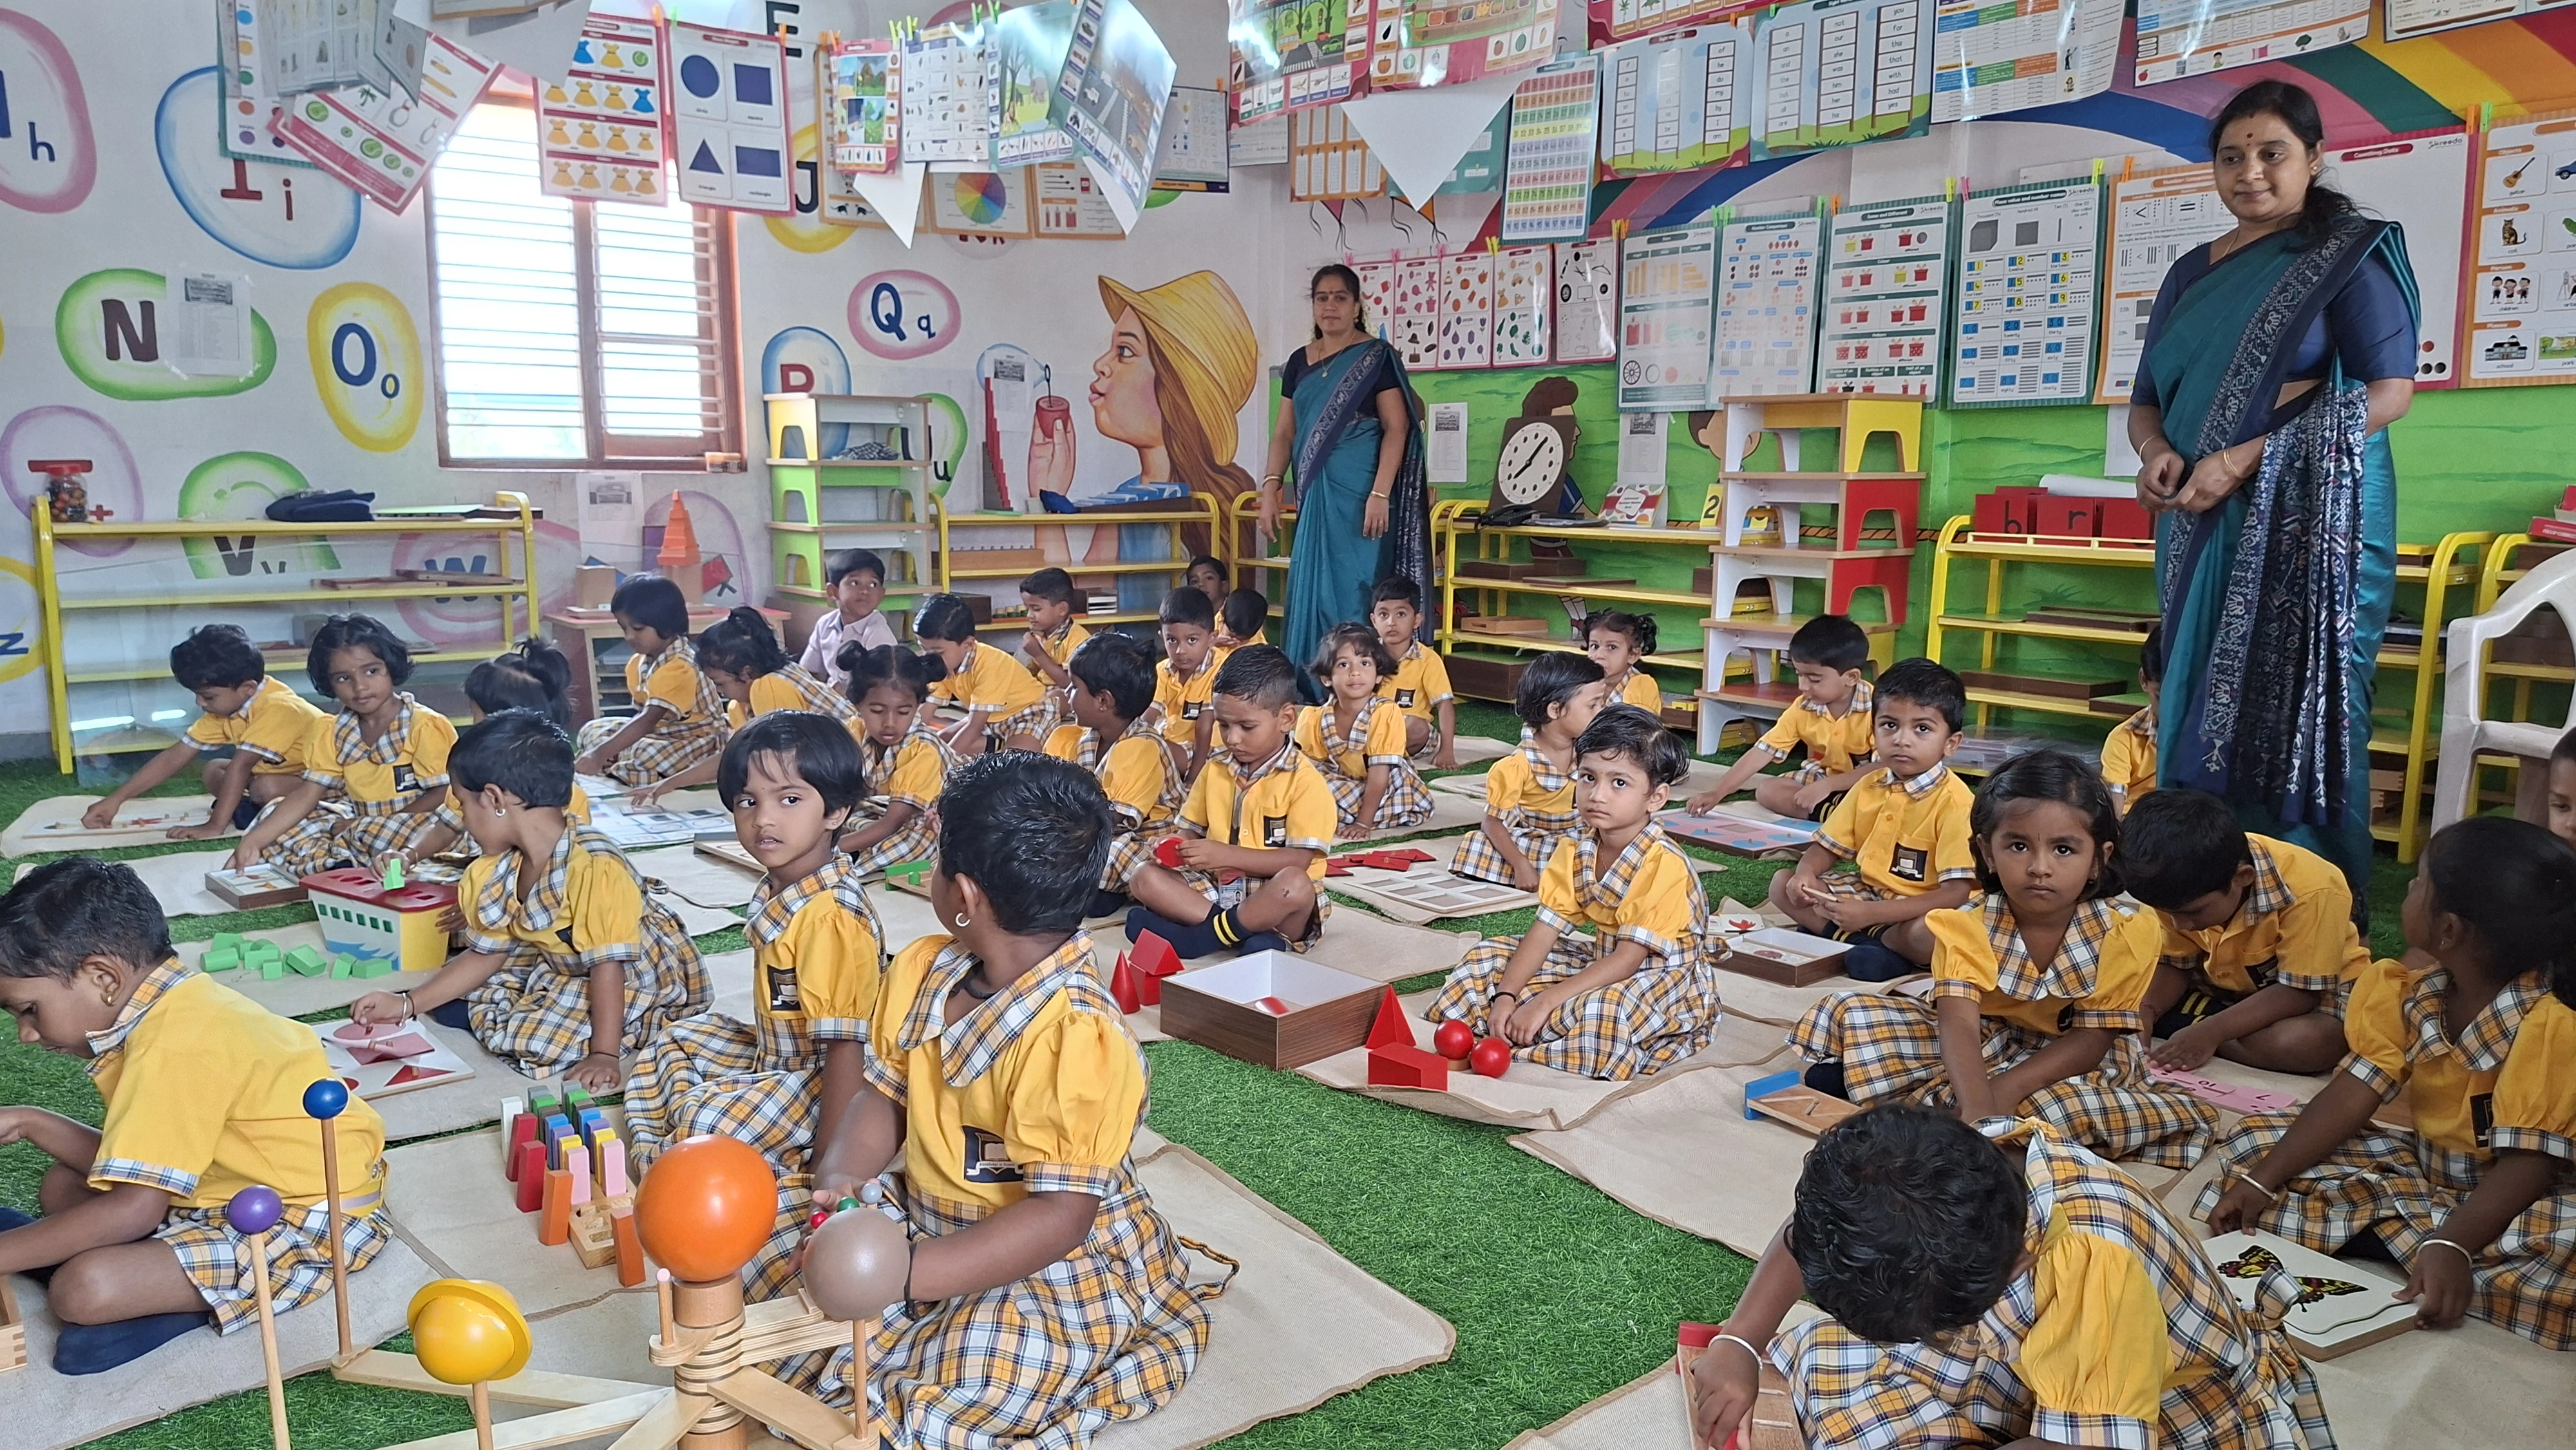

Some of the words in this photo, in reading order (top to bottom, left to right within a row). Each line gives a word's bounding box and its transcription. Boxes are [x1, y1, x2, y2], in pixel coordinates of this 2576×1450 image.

[1893, 7, 1904, 15] you
[1891, 39, 1902, 48] this
[1888, 86, 1900, 95] had
[1888, 101, 1899, 109] yes
[28, 121, 56, 162] h
[795, 160, 819, 214] J
[282, 178, 294, 221] i
[2011, 256, 2023, 266] 12
[2054, 252, 2067, 262] 13
[2010, 277, 2023, 286] 15
[2053, 273, 2067, 283] 16
[1969, 281, 1980, 290] 14
[2009, 297, 2022, 306] 18
[2052, 294, 2065, 303] 19
[1967, 301, 1980, 310] 17
[871, 283, 907, 341] Q
[918, 314, 936, 339] q
[100, 298, 159, 362] N
[2005, 322, 2019, 330] 20
[332, 323, 377, 386] O
[934, 460, 952, 482] u
[1703, 494, 1720, 519] 2
[2004, 500, 2022, 534] b
[2068, 510, 2088, 530] r
